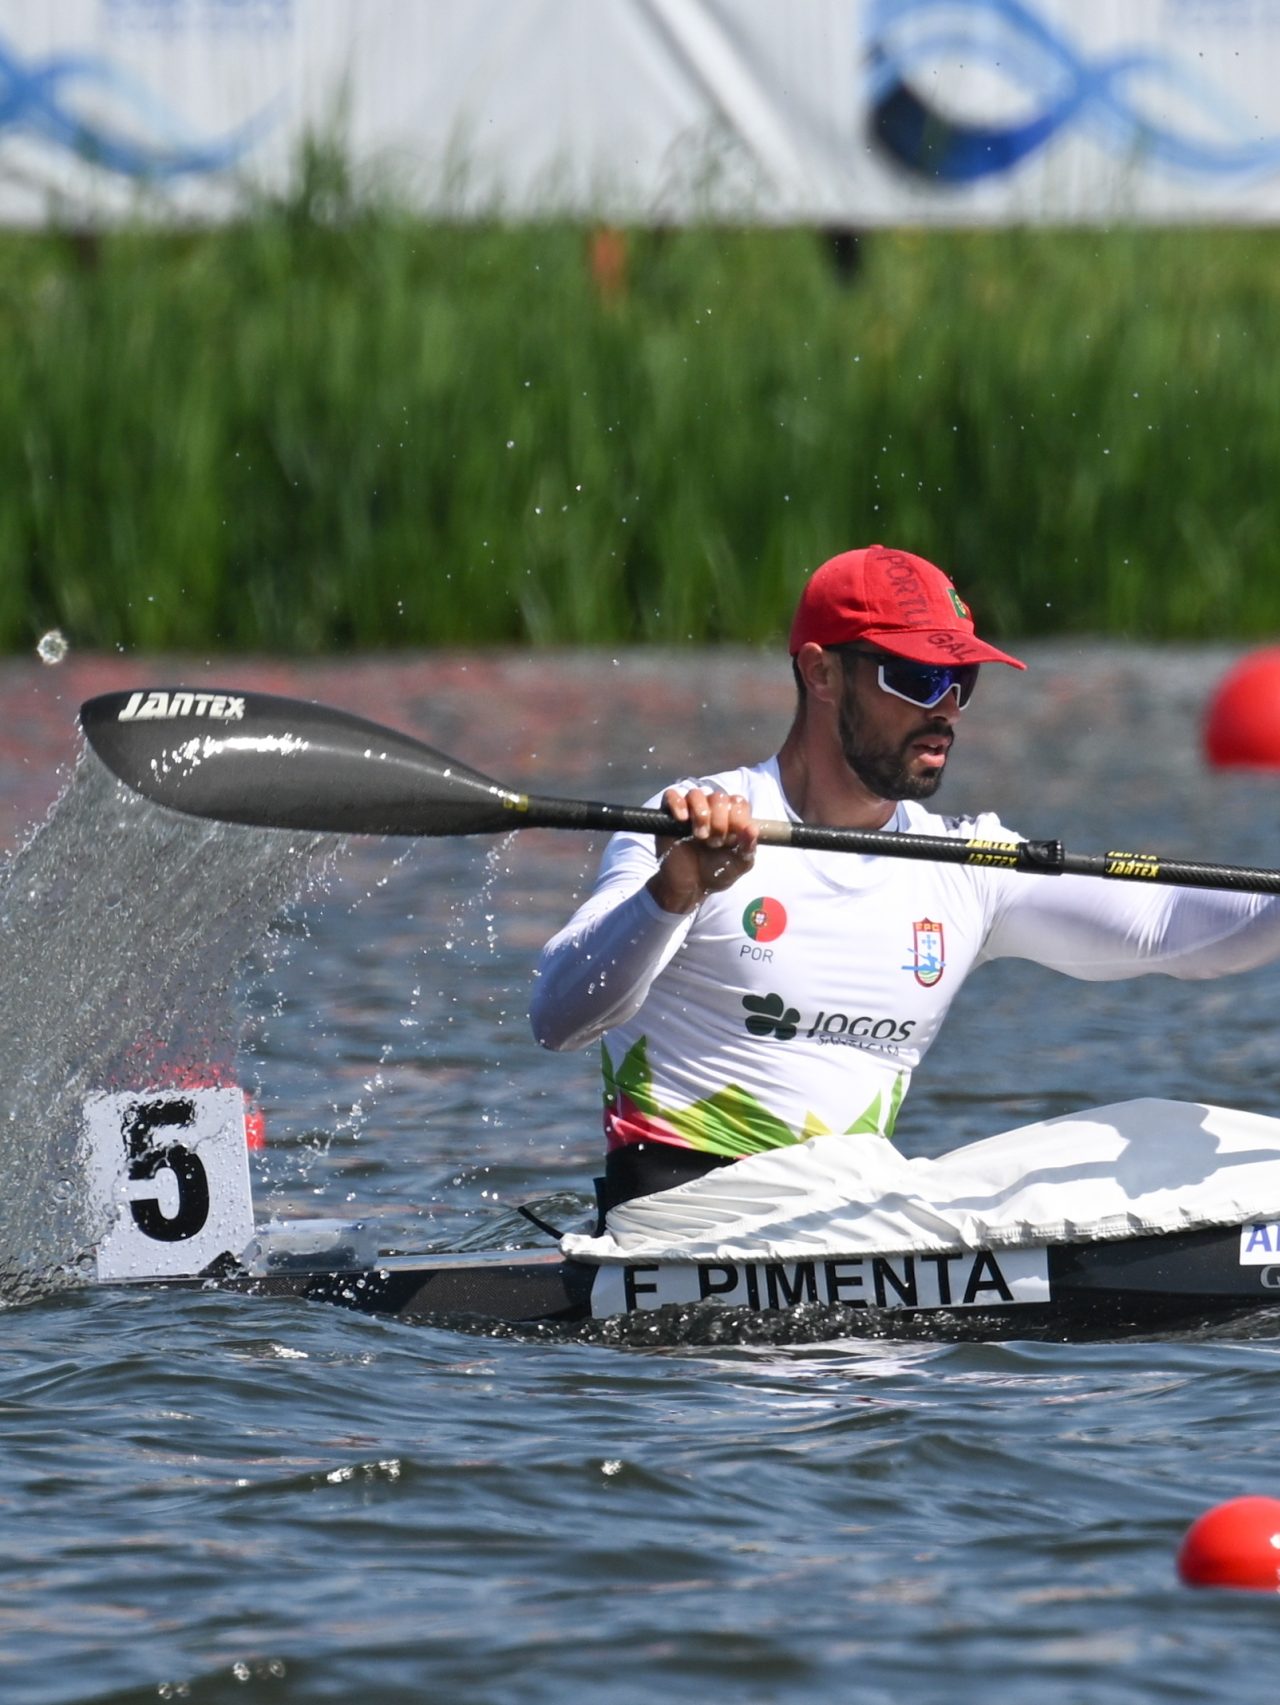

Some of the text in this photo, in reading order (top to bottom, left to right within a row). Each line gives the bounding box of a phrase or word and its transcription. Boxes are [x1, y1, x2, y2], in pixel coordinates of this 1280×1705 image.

[117, 692, 246, 722] JANTEX
[740, 944, 774, 964] POR
[806, 1011, 916, 1042] JOGOS
[122, 1096, 210, 1242] 5
[624, 1250, 1014, 1313] F PIMENTA
